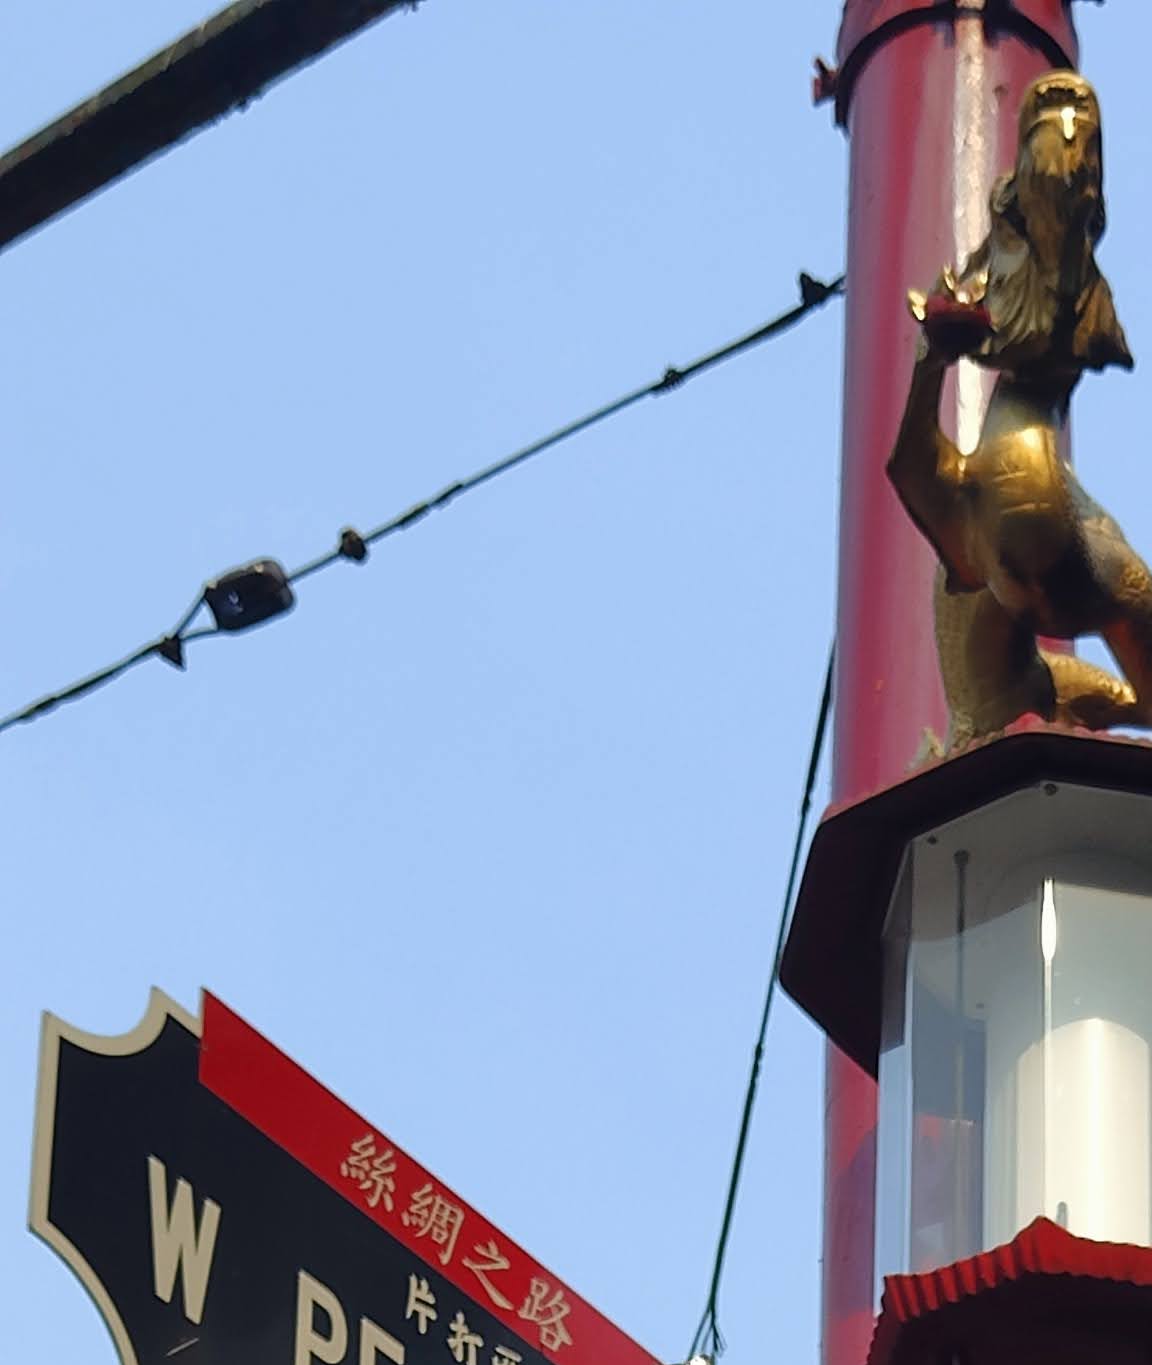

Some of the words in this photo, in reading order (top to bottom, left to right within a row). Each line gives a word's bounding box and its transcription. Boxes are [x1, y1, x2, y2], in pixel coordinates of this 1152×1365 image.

[147, 1155, 221, 1325] W
[341, 1133, 573, 1351] 絲綢之路
